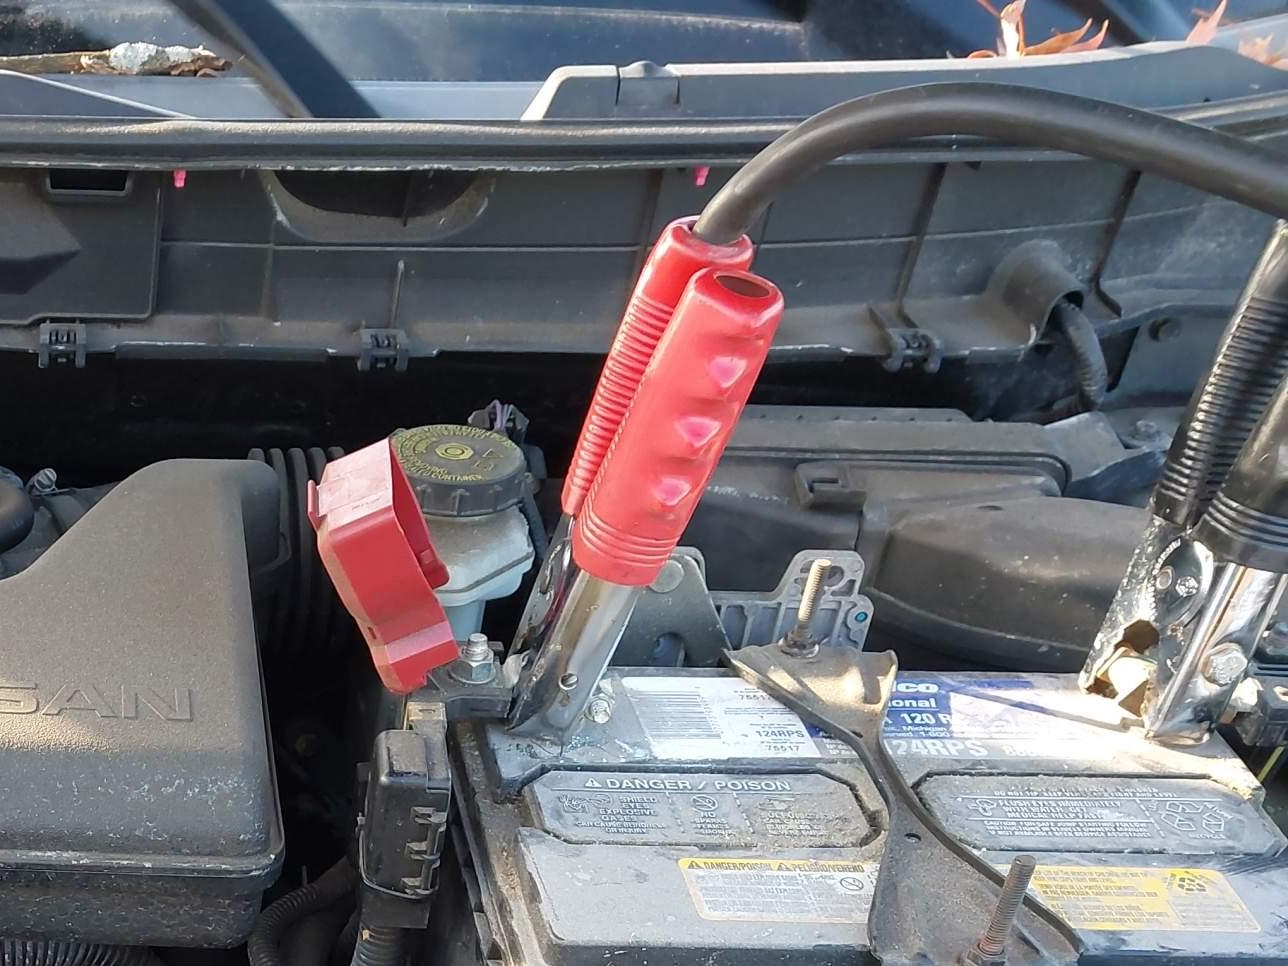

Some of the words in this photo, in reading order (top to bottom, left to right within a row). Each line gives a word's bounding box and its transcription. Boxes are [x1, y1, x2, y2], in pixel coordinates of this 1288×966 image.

[900, 713, 935, 724] 120
[756, 730, 805, 738] 124RPS
[606, 779, 692, 790] DANGER
[714, 781, 791, 791] POISON
[599, 808, 657, 816] EXPLOSIVE
